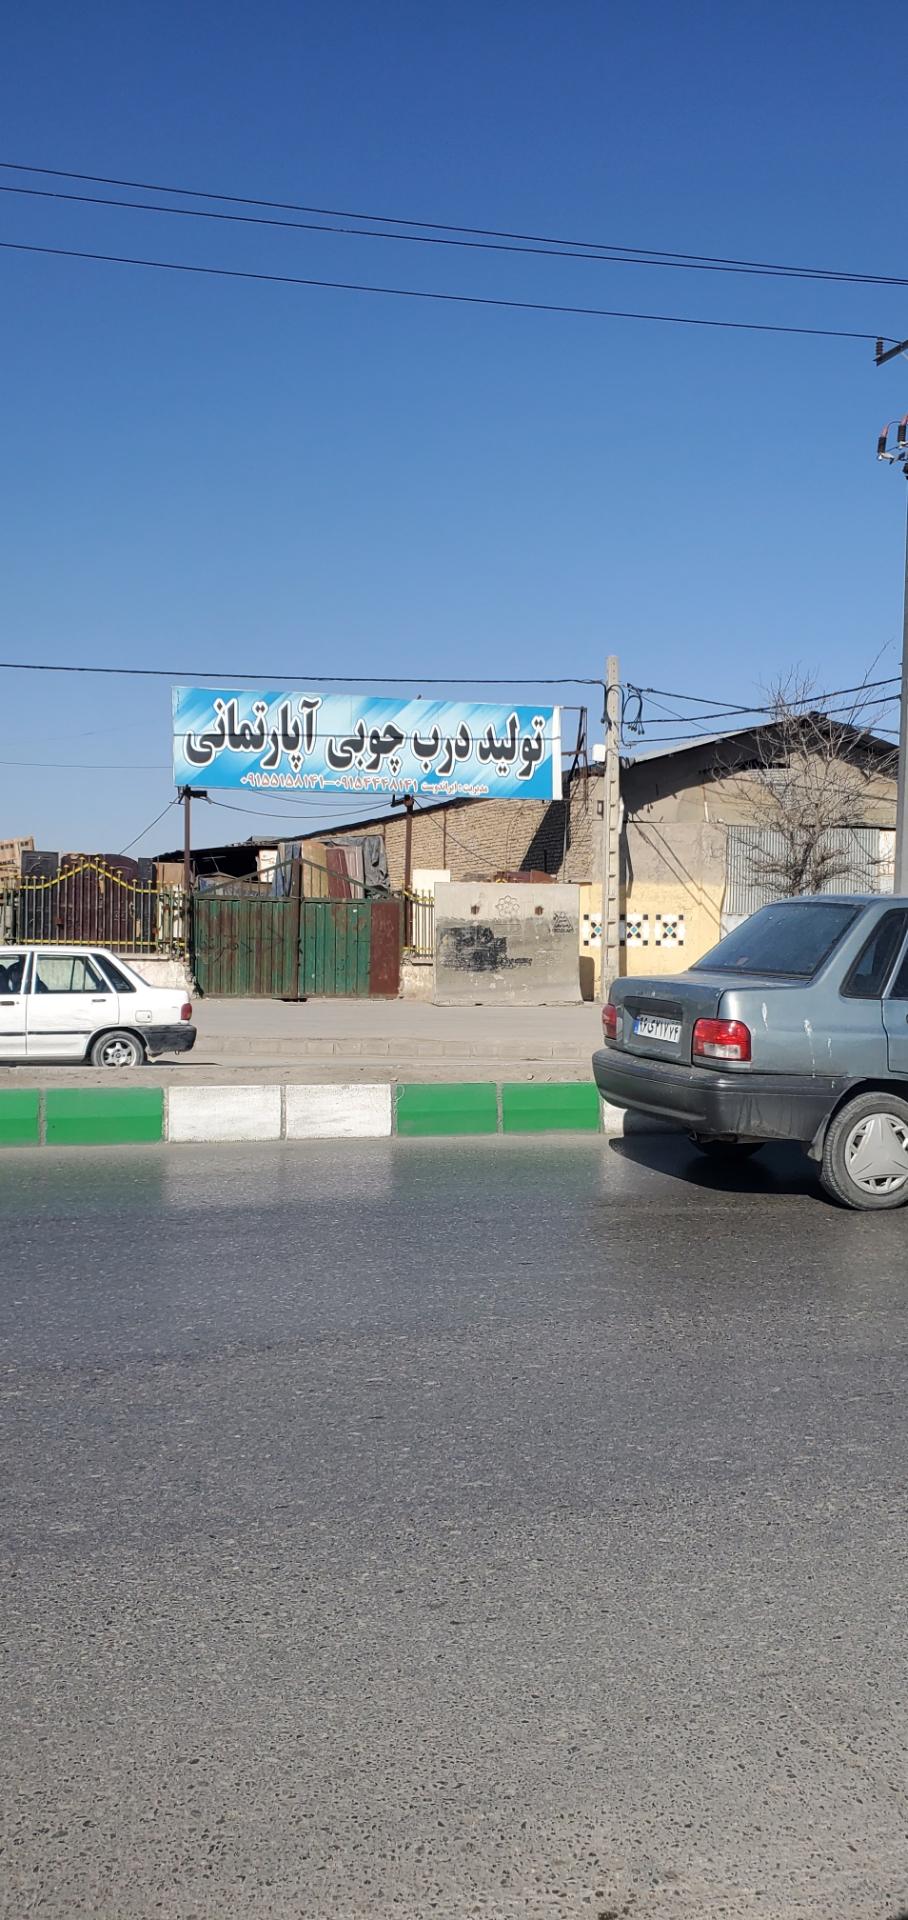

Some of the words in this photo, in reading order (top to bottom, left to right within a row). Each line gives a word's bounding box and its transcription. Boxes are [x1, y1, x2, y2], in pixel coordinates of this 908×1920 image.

[185, 698, 322, 770] آپارتمانی
[328, 720, 405, 774] چوبی
[412, 721, 471, 775] درب
[478, 713, 544, 779] تولید
